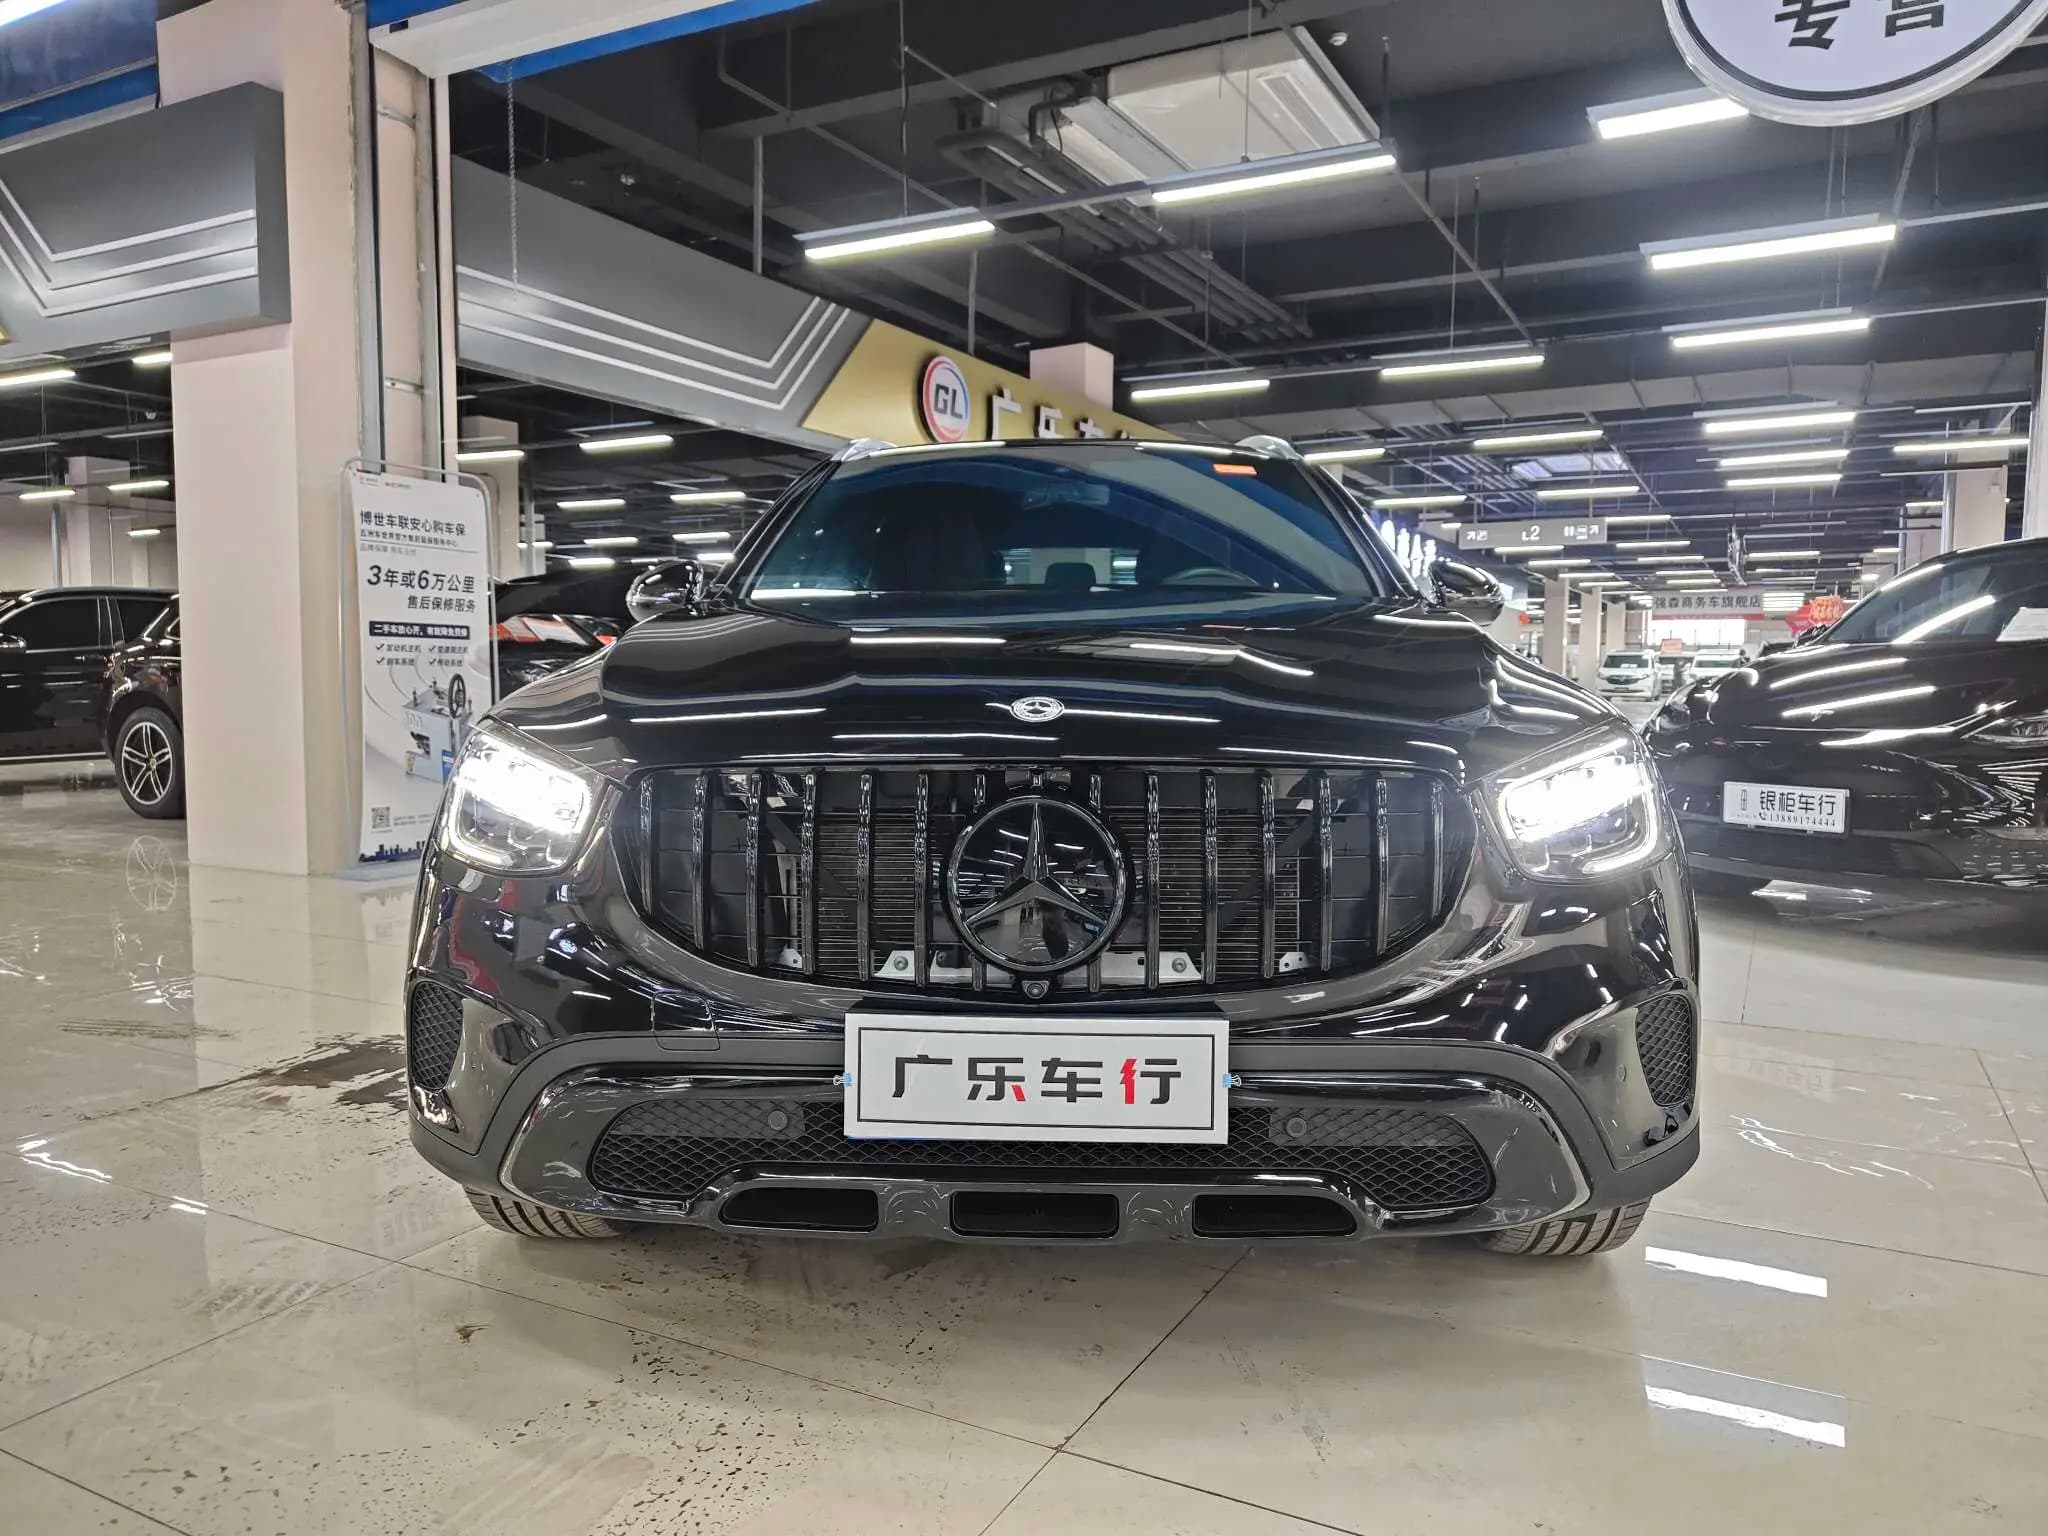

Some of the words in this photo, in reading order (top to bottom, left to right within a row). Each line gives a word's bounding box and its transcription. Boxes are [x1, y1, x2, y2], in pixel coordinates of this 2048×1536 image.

[935, 384, 963, 419] GL
[360, 509, 466, 536] 博世车联安心购车保
[1521, 525, 1541, 541] L2
[367, 564, 475, 594] 3年或6万公里
[407, 595, 476, 613] 售后保修服务
[1759, 790, 1836, 816] 银柜车行
[891, 1054, 1182, 1104] 广乐车行
